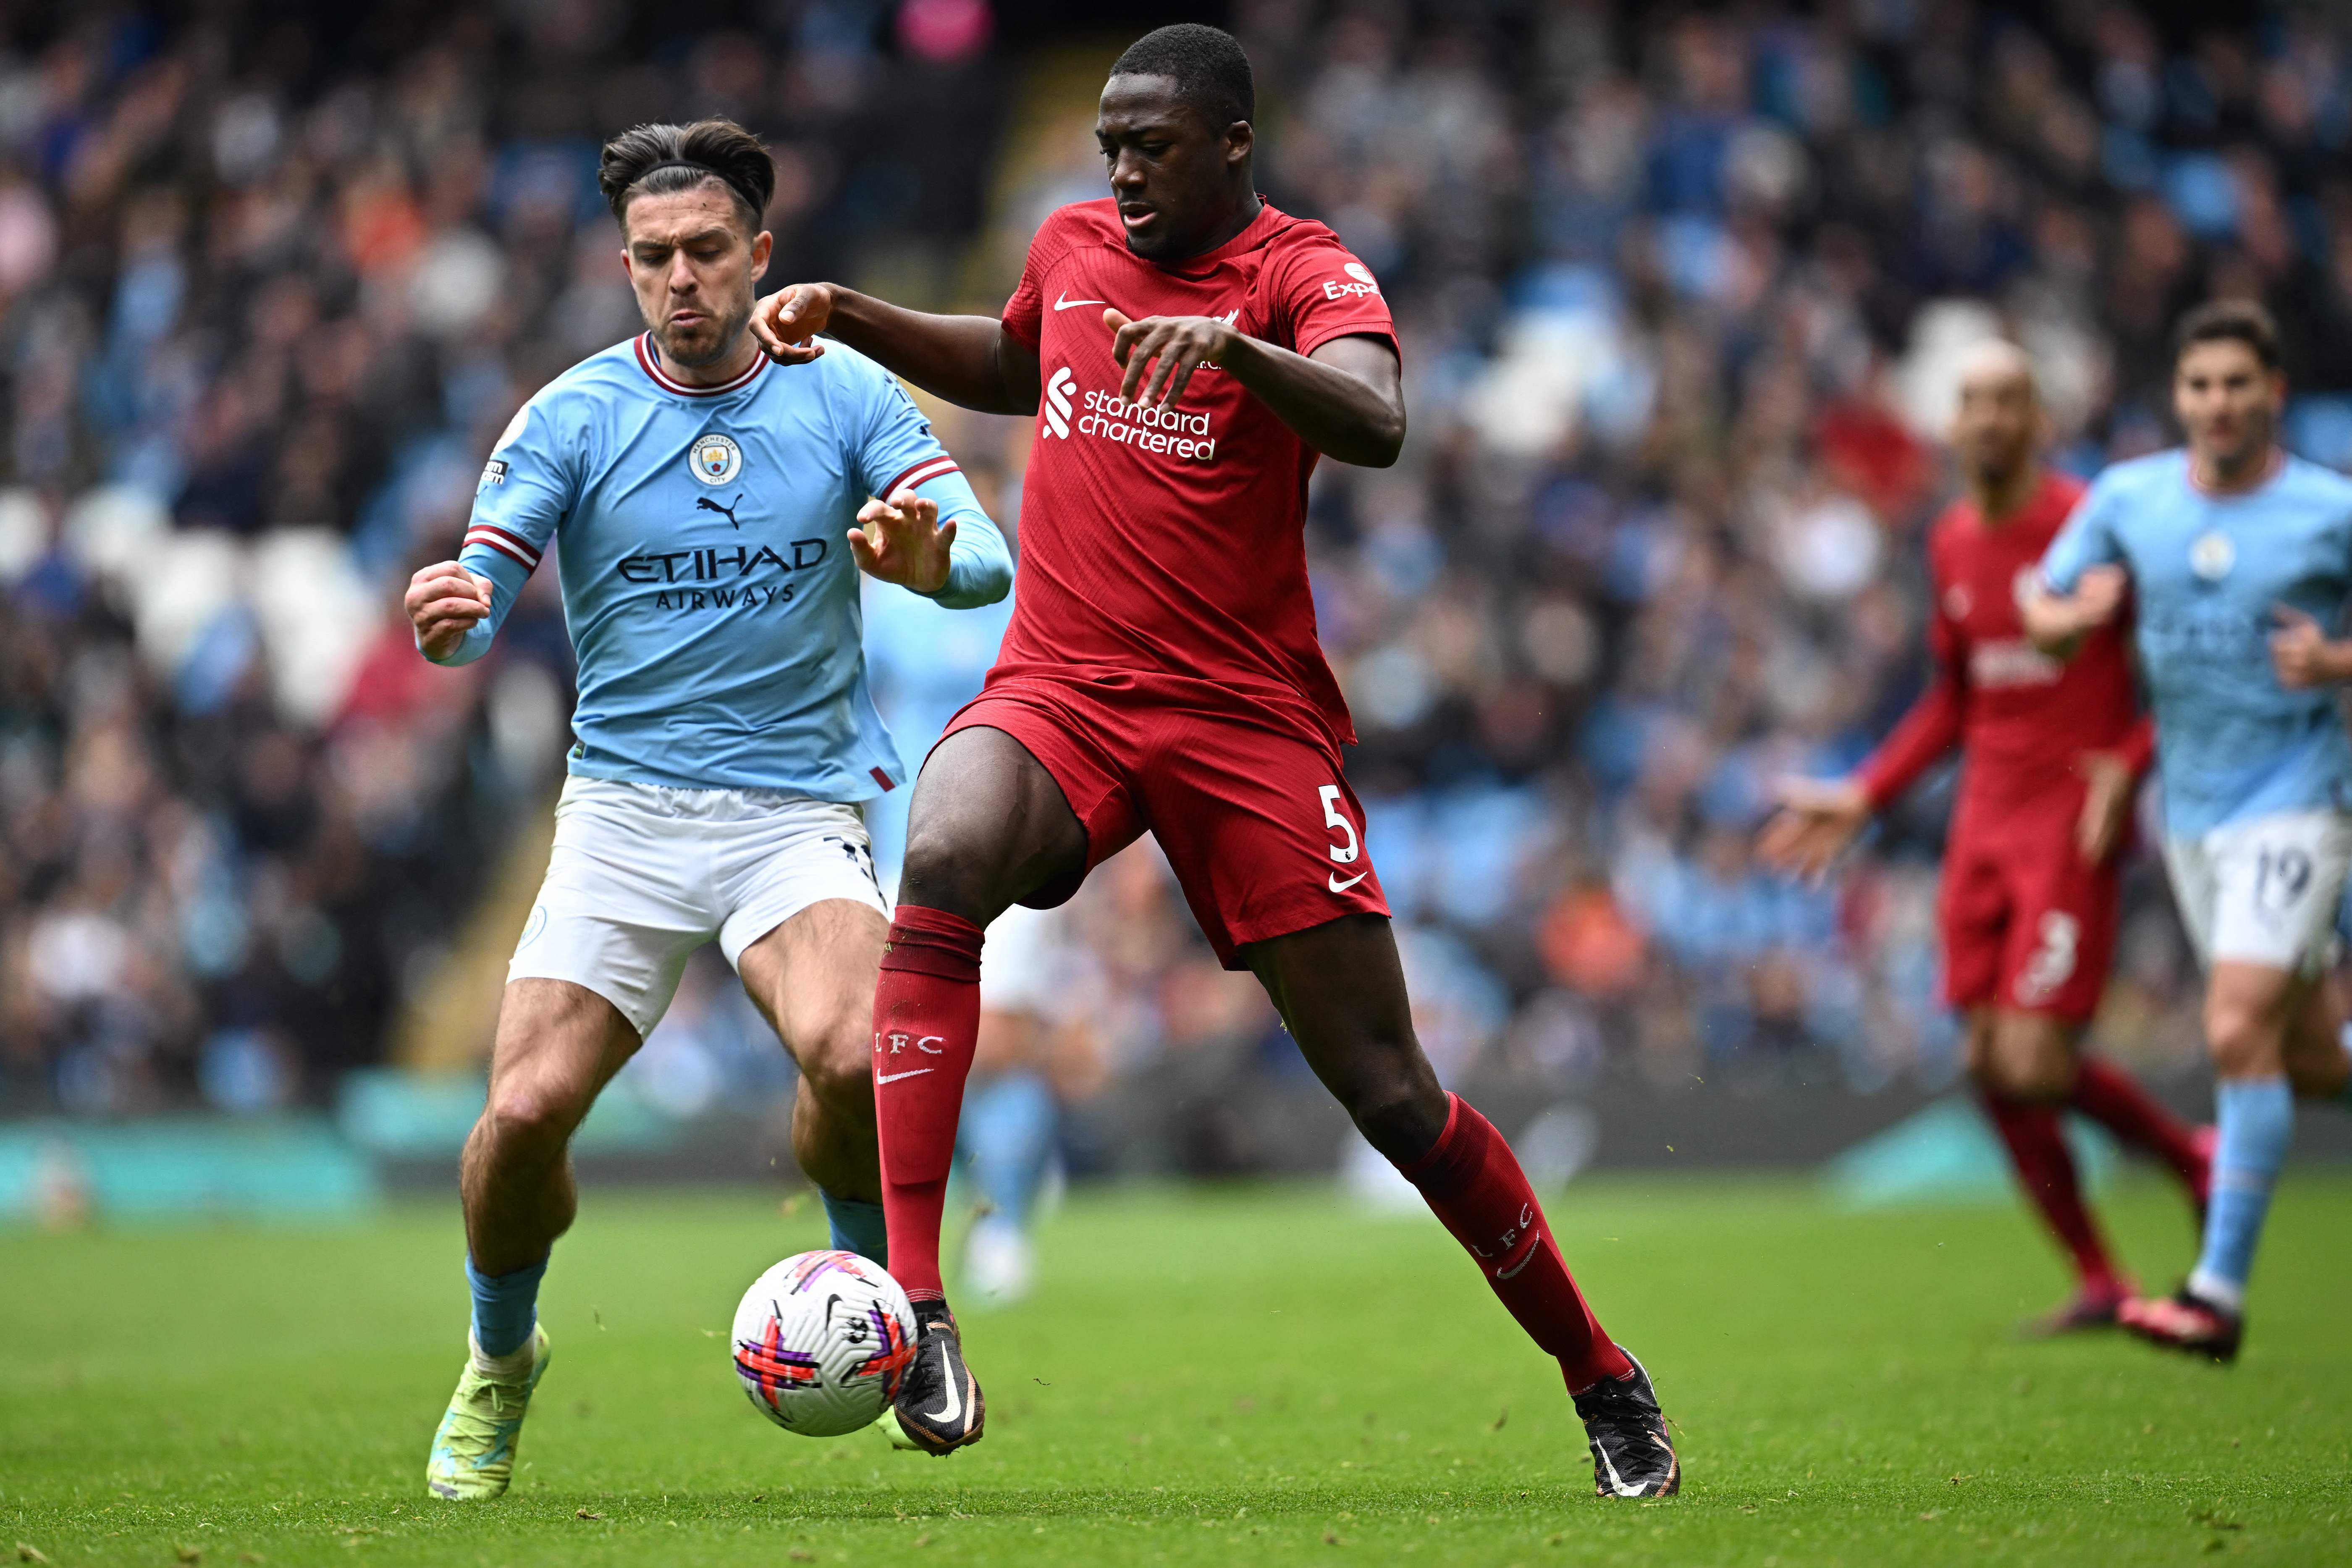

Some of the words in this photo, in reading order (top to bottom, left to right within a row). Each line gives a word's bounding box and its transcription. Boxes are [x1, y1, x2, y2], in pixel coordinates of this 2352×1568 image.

[1323, 280, 1381, 300] Expe
[1084, 389, 1209, 436] standard
[693, 437, 736, 454] MANCHESTER
[1078, 412, 1215, 460] chartered
[616, 538, 827, 582] ETIHAD
[656, 583, 794, 609] AIRWAYS
[1317, 784, 1359, 863] 5
